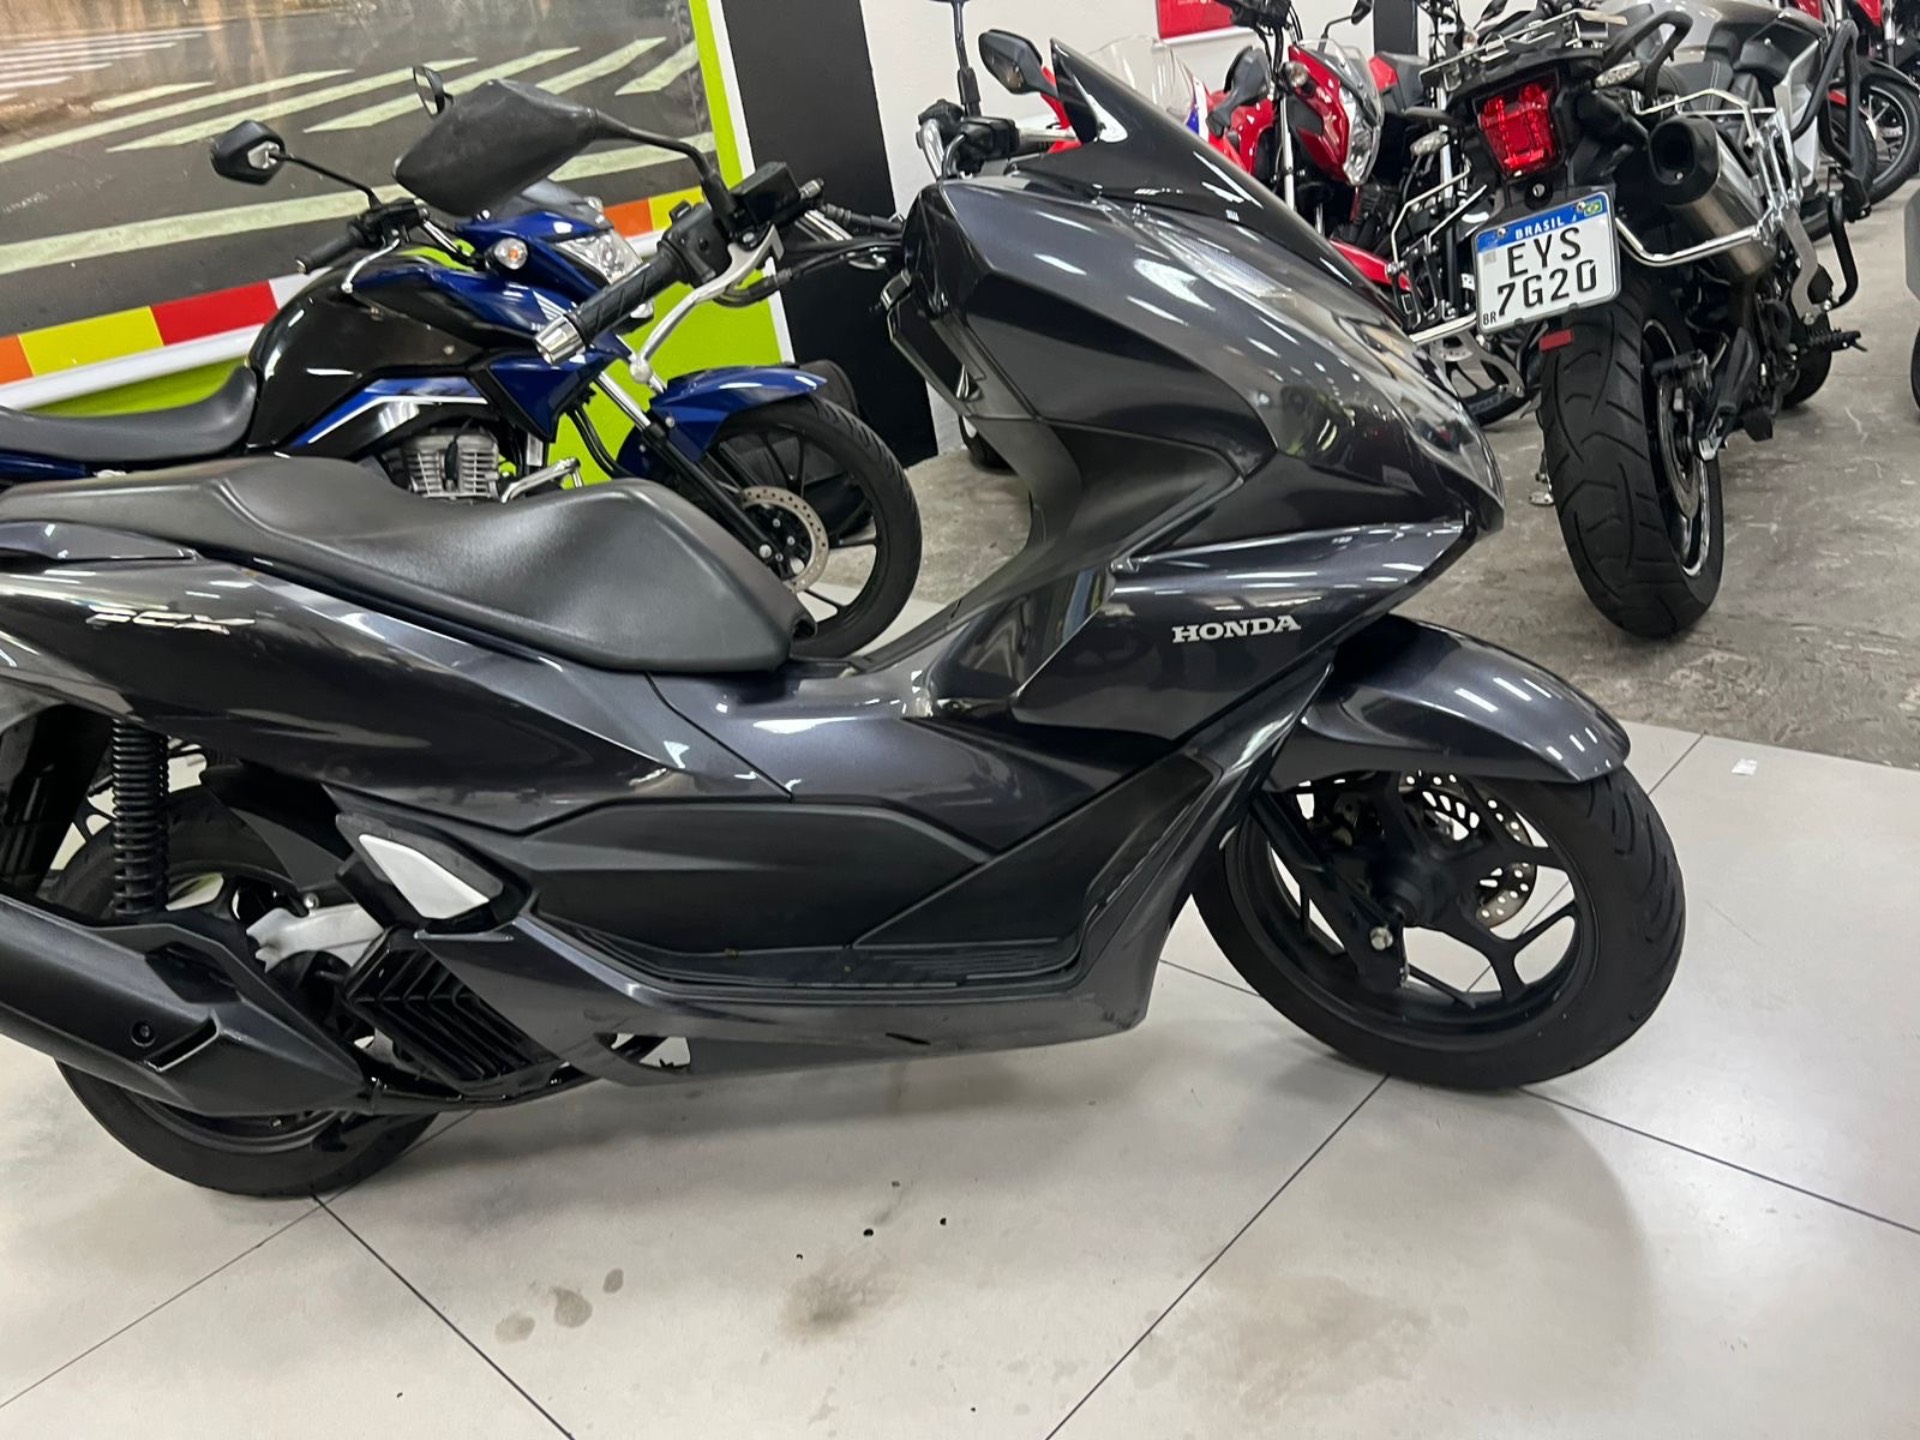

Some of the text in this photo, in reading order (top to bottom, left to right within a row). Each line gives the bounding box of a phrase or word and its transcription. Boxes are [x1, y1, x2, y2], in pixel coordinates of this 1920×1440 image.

[1515, 216, 1564, 239] BRASIL
[1507, 227, 1581, 278] EYS
[1497, 259, 1597, 317] 7G20
[1482, 311, 1497, 325] BR
[1172, 614, 1301, 643] HONDA
